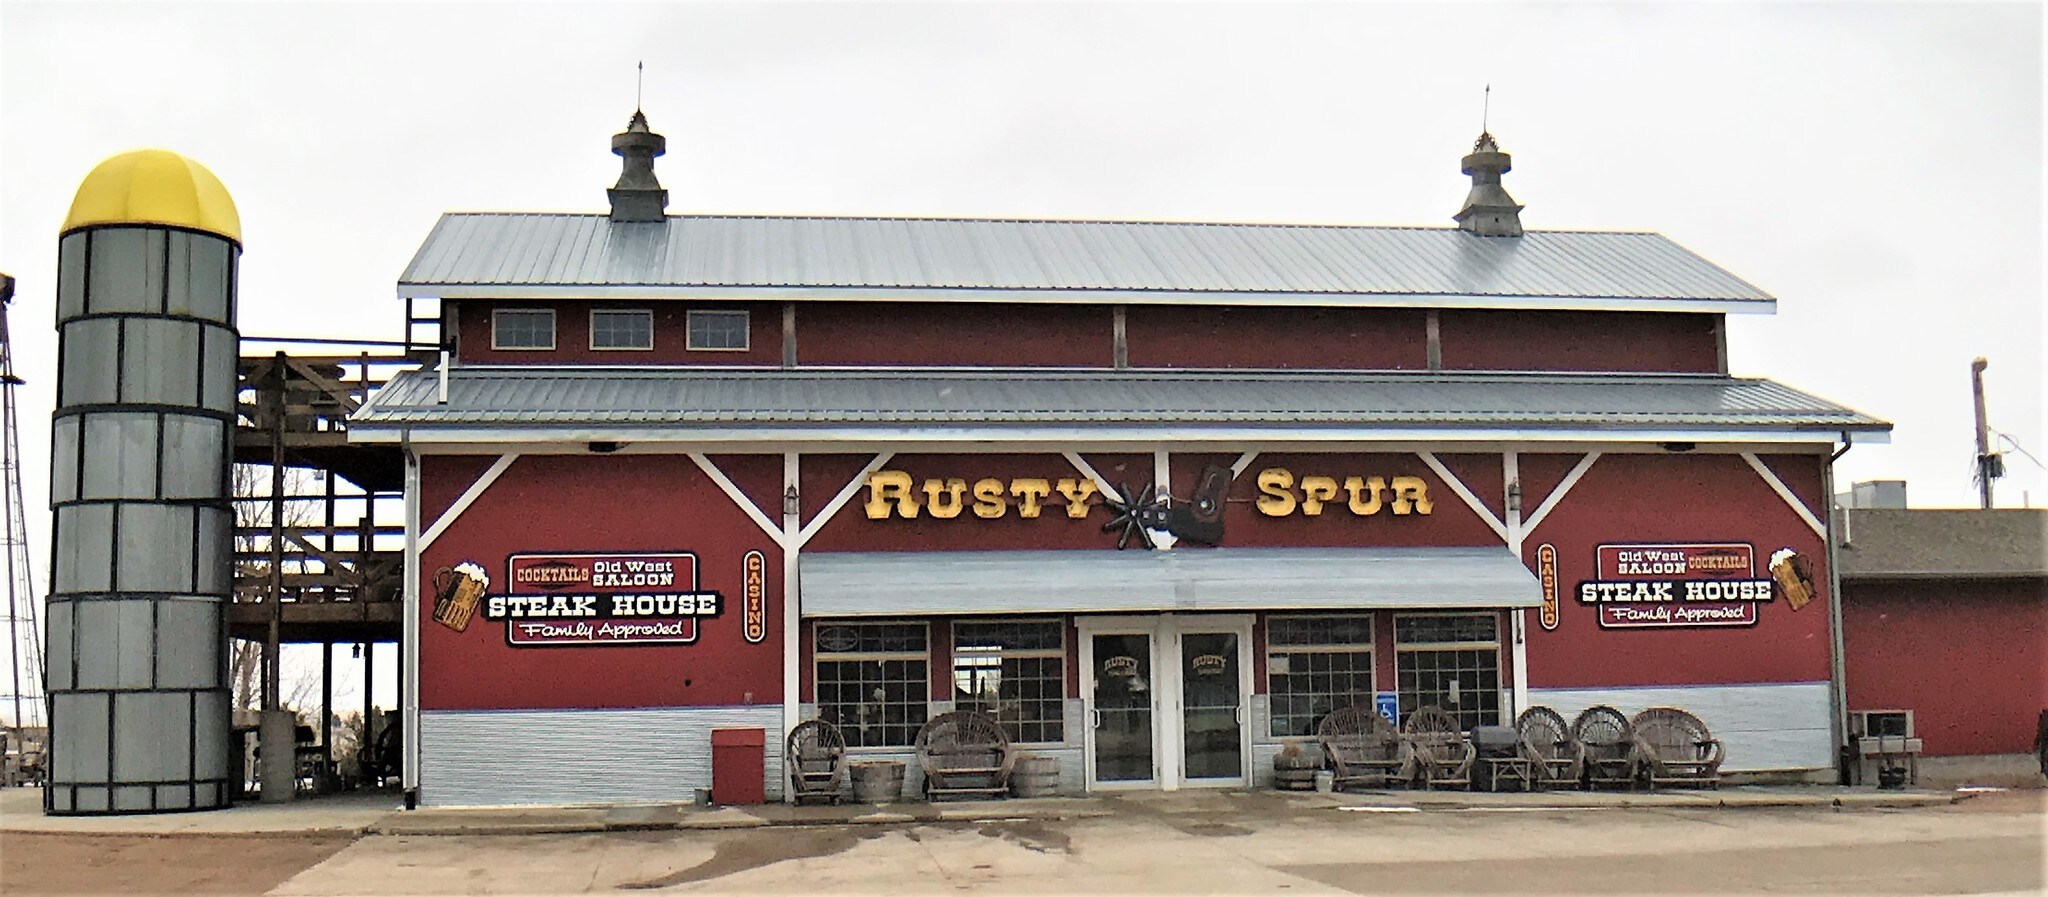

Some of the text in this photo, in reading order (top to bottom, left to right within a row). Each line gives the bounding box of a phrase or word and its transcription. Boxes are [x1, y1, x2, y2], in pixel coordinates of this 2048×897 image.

[863, 467, 1434, 519] RUSTY SPUR
[1618, 550, 1685, 562] Old West
[1688, 555, 1748, 570] COCKTAILS
[517, 566, 590, 582] COCKTAILS
[594, 560, 673, 573] Old West
[1618, 562, 1686, 574] SALOON
[593, 574, 674, 586] SALOON
[1541, 549, 1556, 625] CASINO
[747, 557, 761, 638] CASINO
[1581, 581, 1771, 602] STEAK HOUSE
[488, 594, 717, 617] STEAK HOUSE
[1608, 605, 1745, 623] Family Approved
[519, 620, 683, 640] Family Approved
